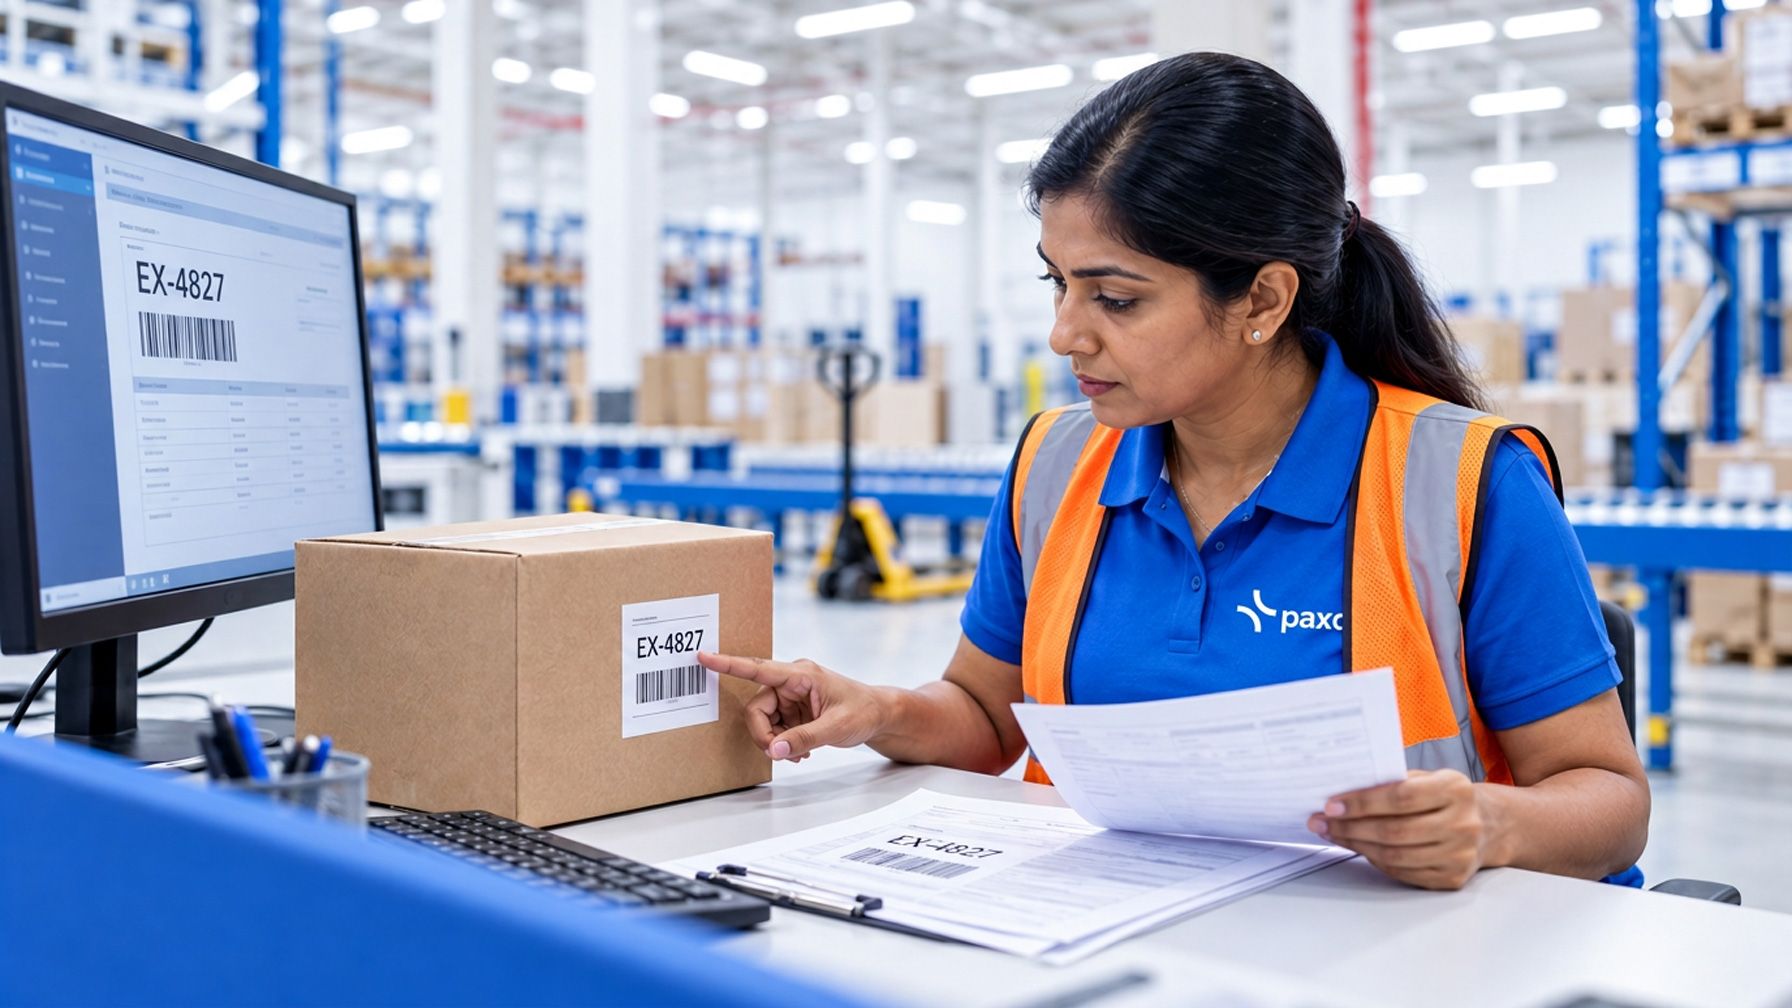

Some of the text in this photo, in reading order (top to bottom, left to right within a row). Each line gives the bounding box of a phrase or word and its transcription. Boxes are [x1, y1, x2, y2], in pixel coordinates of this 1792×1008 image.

[136, 260, 224, 302] EX-4827
[637, 629, 704, 659] EX-4827
[887, 835, 1004, 858] EX-4827
